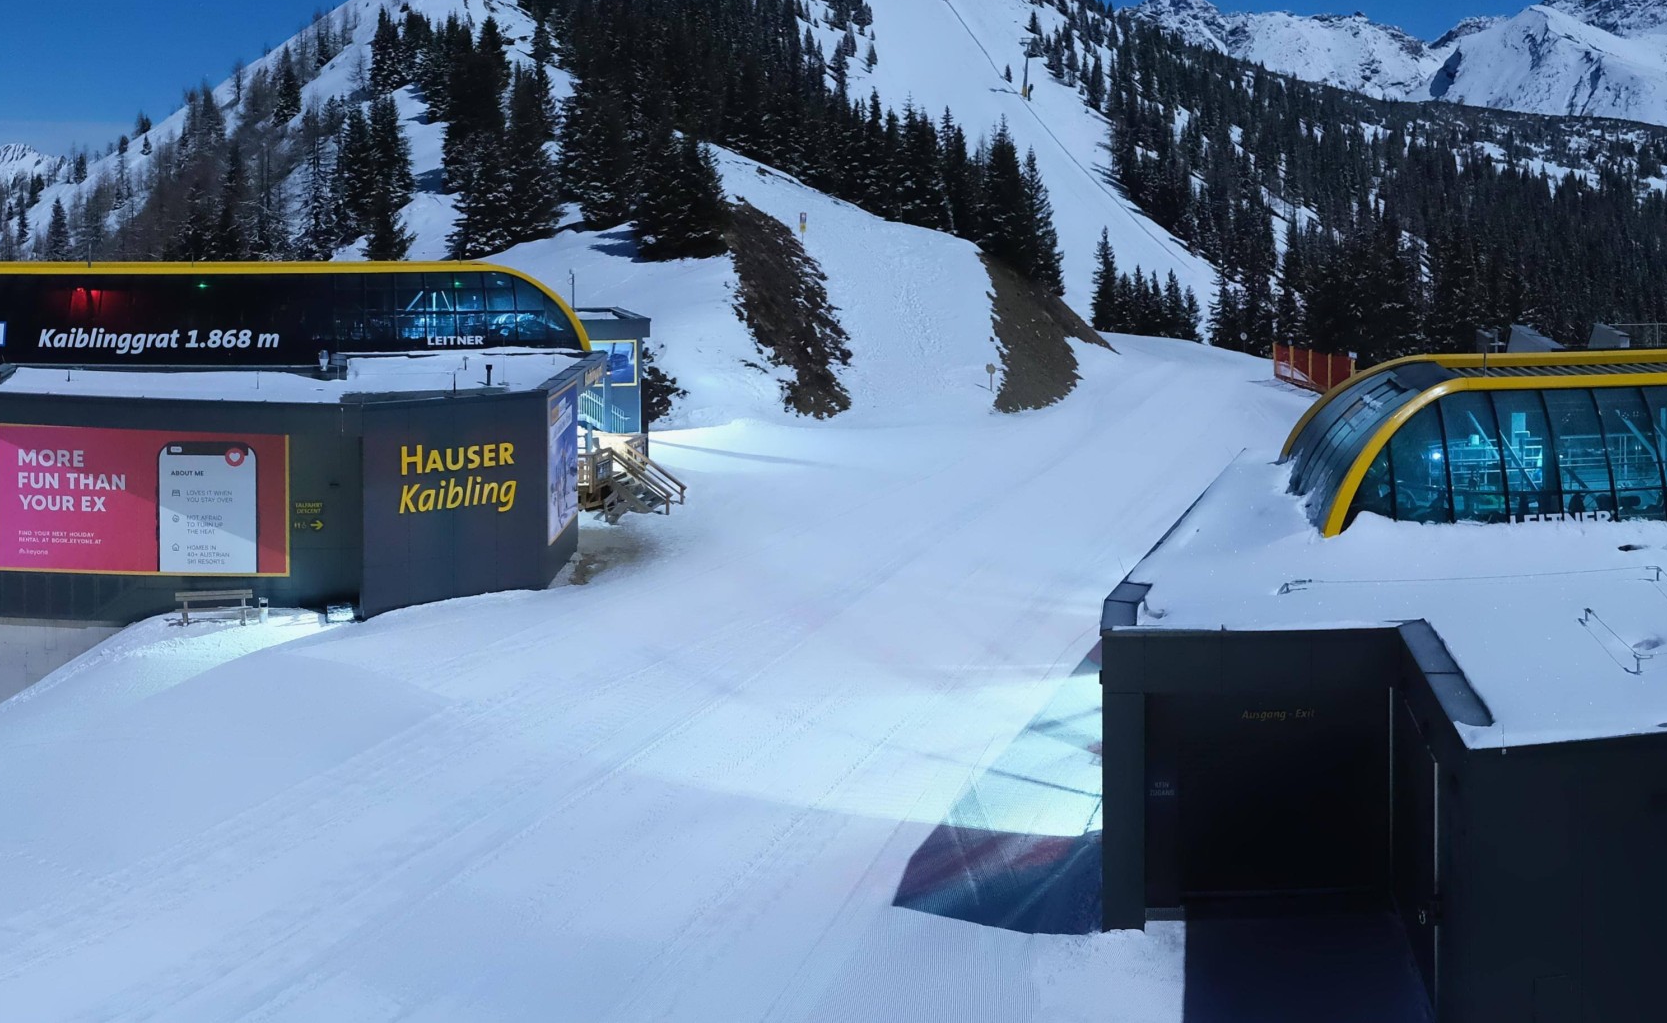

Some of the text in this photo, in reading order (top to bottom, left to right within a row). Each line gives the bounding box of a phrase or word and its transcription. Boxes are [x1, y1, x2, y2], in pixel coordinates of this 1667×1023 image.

[38, 328, 280, 354] Kaiblinggrat 1.868 m
[427, 335, 484, 346] LEITNER
[18, 449, 84, 467] MORE
[401, 442, 515, 476] HAUSER
[18, 472, 126, 490] FUN THAN
[19, 495, 106, 512] YOUR EX
[398, 476, 517, 514] Kaibling
[1241, 709, 1286, 721] Ausgang
[1295, 707, 1316, 718] Exit
